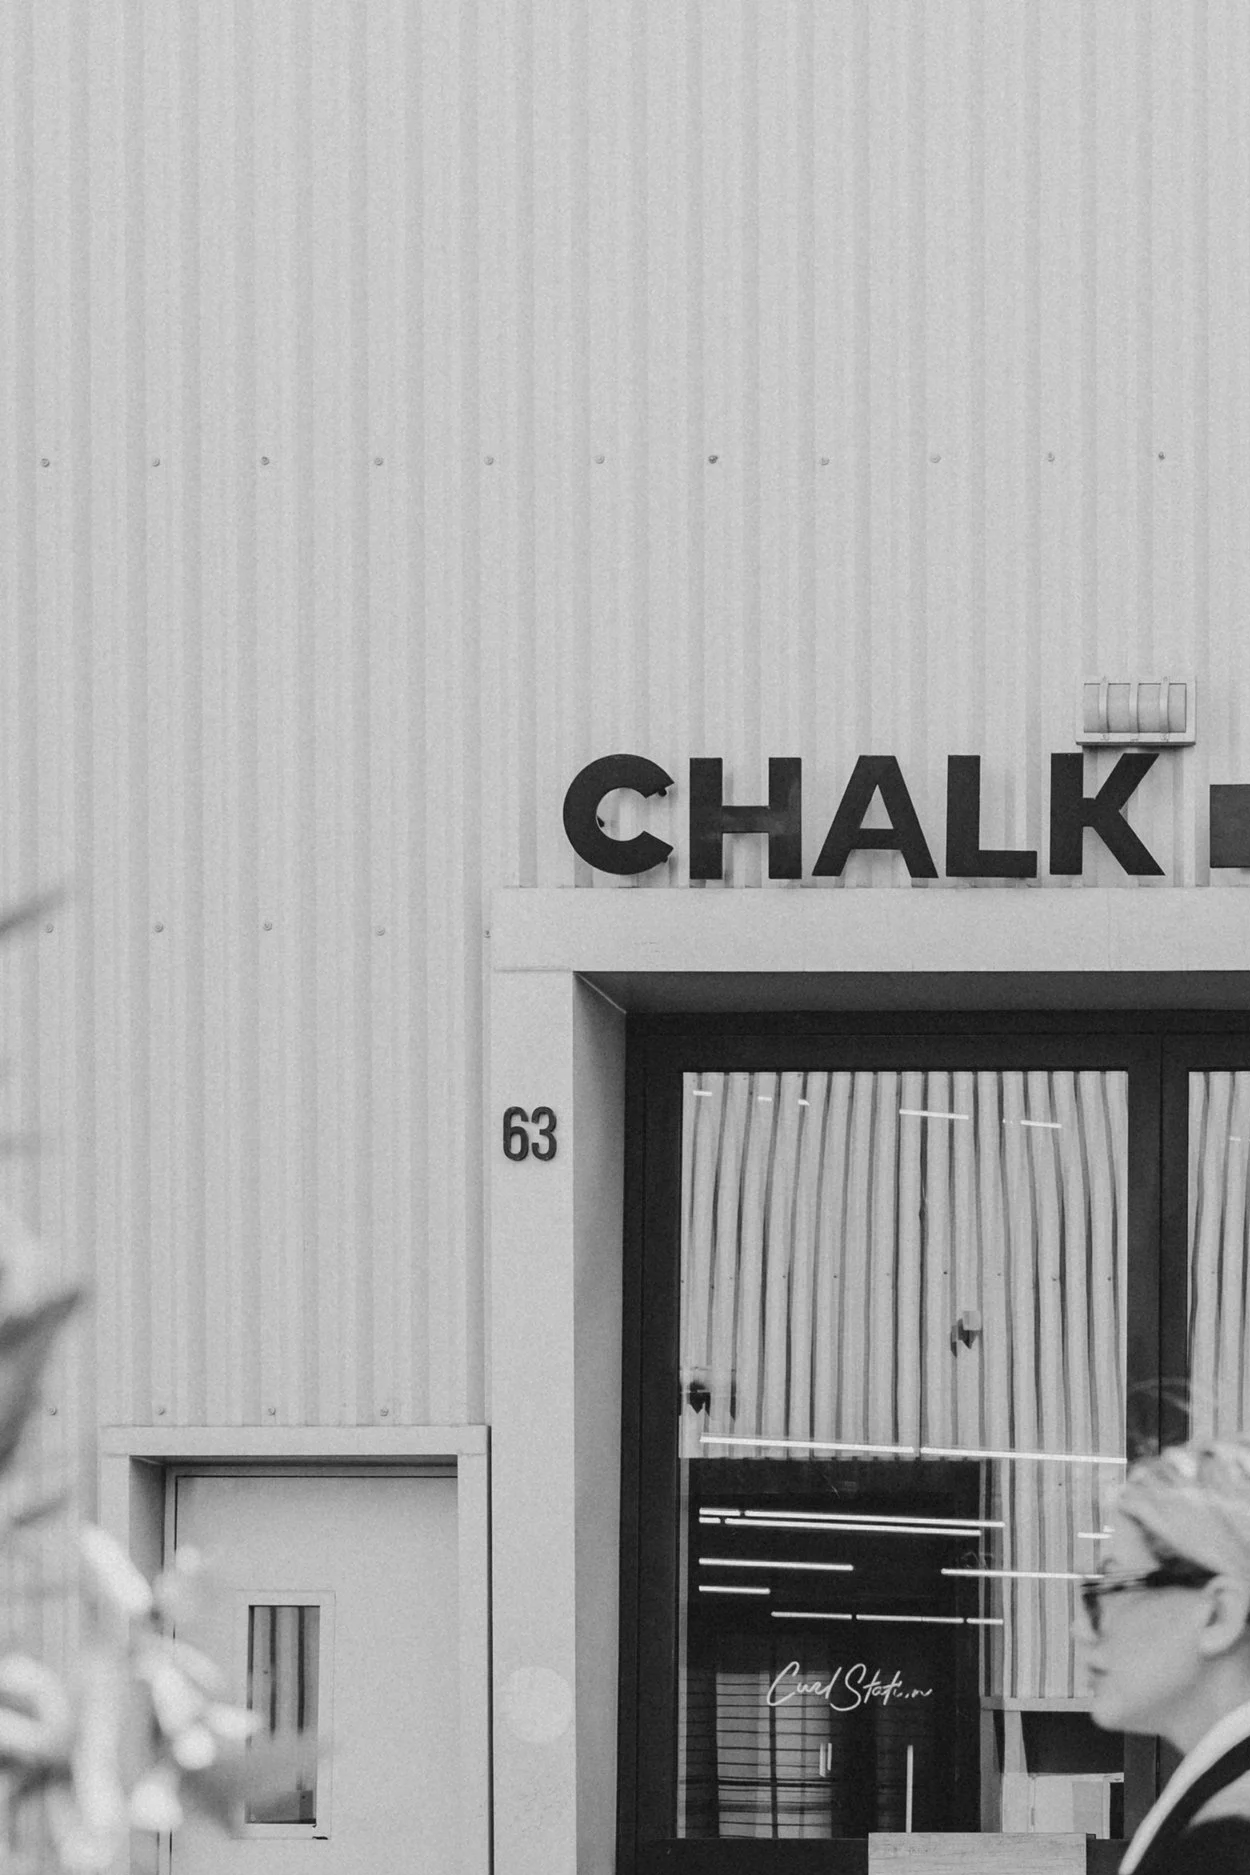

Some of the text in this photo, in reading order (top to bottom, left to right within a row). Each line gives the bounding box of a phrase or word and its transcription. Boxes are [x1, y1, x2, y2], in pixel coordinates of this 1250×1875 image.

[562, 752, 1167, 880] CHALK
[502, 1105, 558, 1162] 63
[830, 1662, 933, 1712] Statin
